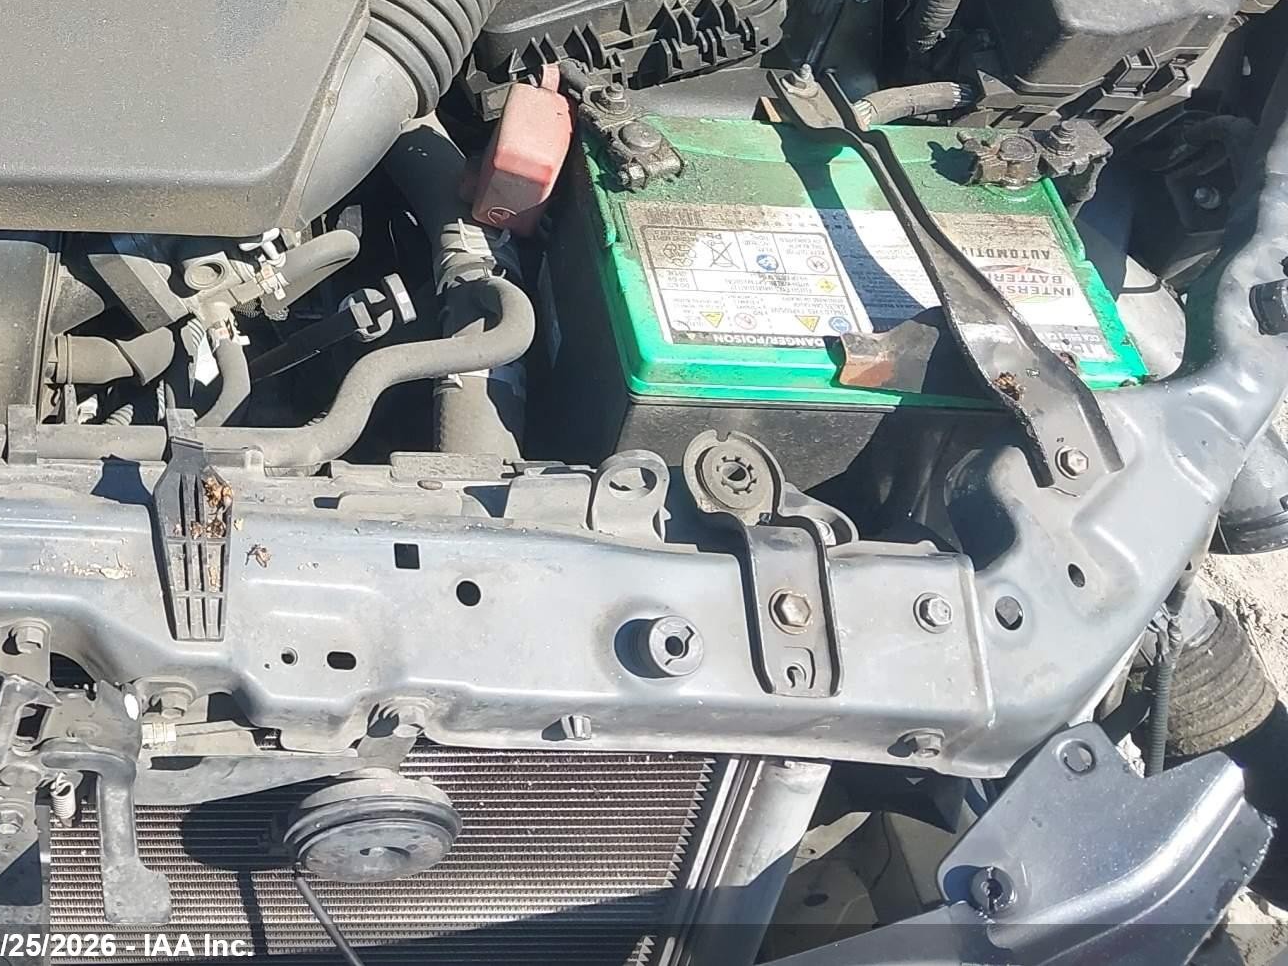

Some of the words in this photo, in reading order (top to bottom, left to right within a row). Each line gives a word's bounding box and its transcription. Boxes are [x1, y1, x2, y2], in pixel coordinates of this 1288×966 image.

[961, 247, 1050, 260] AUTOMOTIV
[987, 273, 1062, 284] BATTERI
[996, 285, 1072, 297] INTERST
[714, 334, 826, 348] DANGER/POISON
